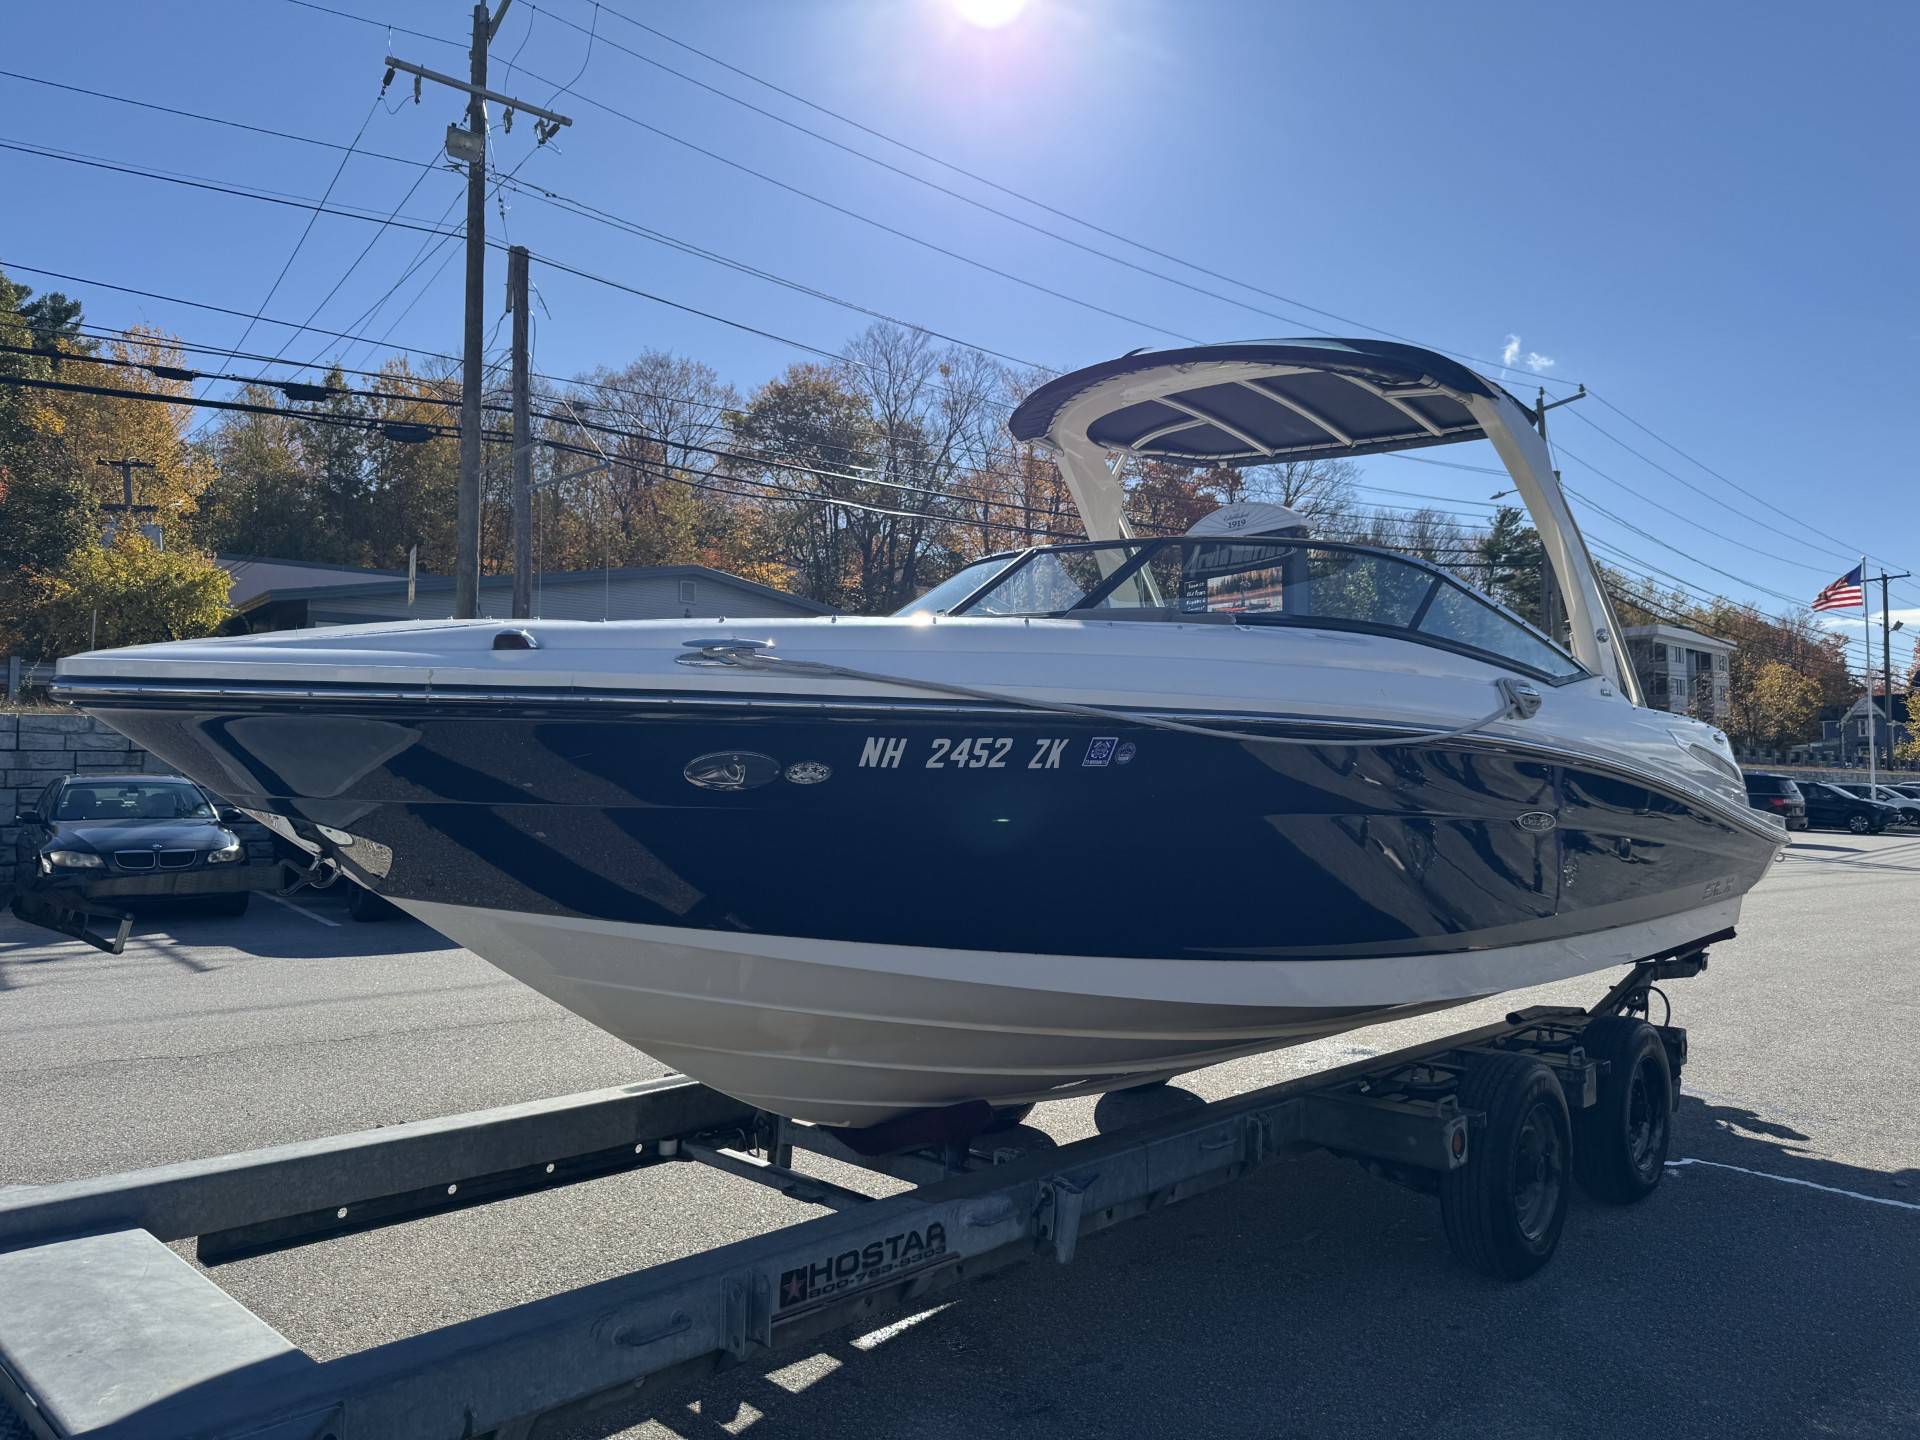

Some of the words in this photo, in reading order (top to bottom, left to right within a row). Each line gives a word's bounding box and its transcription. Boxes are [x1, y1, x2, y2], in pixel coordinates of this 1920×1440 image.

[1228, 518, 1247, 529] 1919
[859, 736, 908, 769] NH
[925, 737, 1014, 769] 2452
[1027, 738, 1070, 769] ZK
[808, 1221, 947, 1288] HOSTAR
